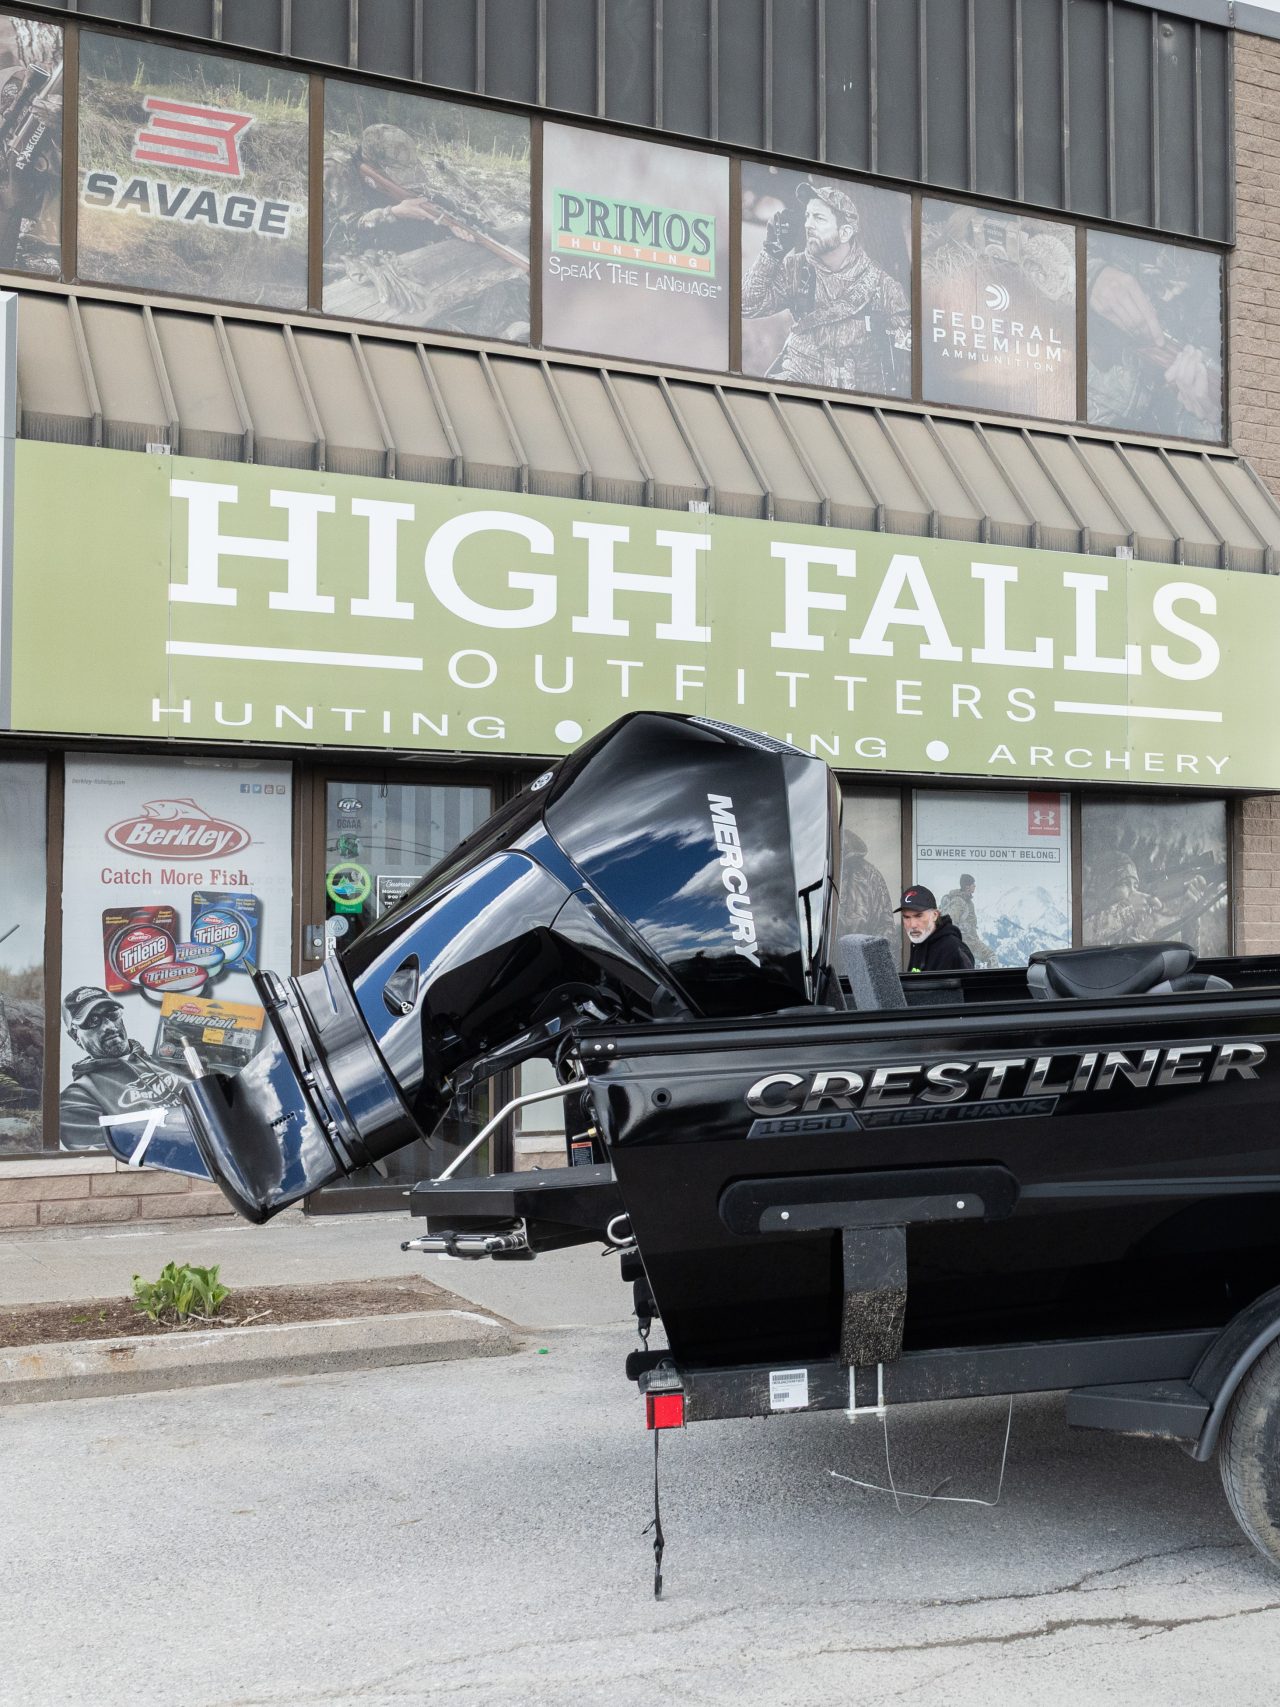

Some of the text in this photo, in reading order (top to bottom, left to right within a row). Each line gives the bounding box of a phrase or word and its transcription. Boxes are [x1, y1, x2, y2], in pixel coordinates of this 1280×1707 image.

[84, 172, 290, 235] SAVAGE
[558, 193, 711, 256] PRIMOS
[571, 238, 698, 268] HUNTING
[549, 256, 718, 299] SPEAK THE LANGUAGE
[932, 308, 1062, 345] FEDERAL
[932, 327, 1062, 362] PREMIUM
[941, 348, 1054, 372] AMMUNITION
[168, 478, 1221, 681] HIGH FALLS
[447, 648, 1037, 723] OUTFITTERS
[152, 697, 1231, 775] HUNTING ARCHERY
[125, 823, 234, 851] Berkley
[920, 848, 933, 857] GO
[935, 848, 966, 857] WHERE
[969, 849, 987, 858] YOU
[989, 850, 1017, 859] DON'T
[100, 867, 249, 886] Catch More Fish
[707, 793, 761, 968] MERCURY
[196, 923, 239, 944] Trilene
[121, 937, 167, 970] Trilene
[176, 945, 214, 958] rilene
[146, 966, 197, 982] Trilene
[744, 1042, 1268, 1116] CRESTLINER
[759, 1116, 849, 1135] 1850
[957, 1100, 1050, 1119] HAWK
